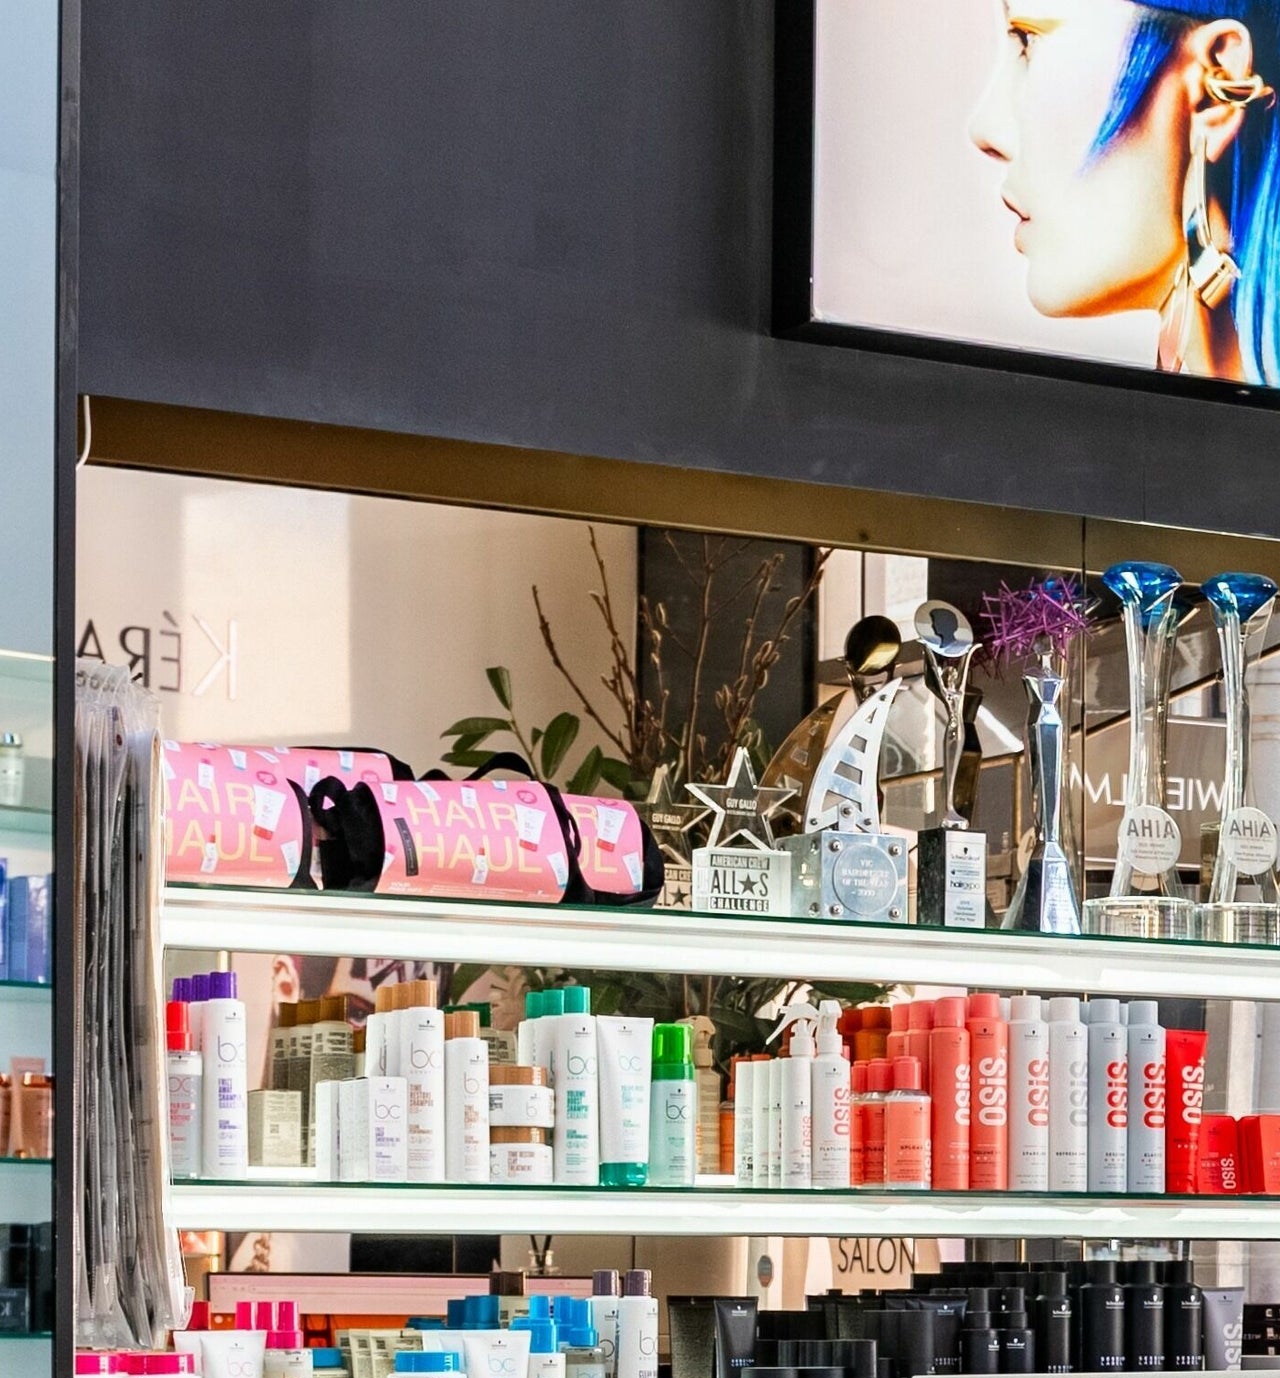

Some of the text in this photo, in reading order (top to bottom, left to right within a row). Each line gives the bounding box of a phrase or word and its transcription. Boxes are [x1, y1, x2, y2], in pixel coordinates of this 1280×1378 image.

[165, 777, 256, 817] AIR
[406, 795, 518, 833] HAIR
[726, 797, 757, 810] GUY GALLO
[165, 820, 274, 863] AUL
[415, 831, 543, 875] HAUL
[711, 855, 770, 870] AMERICAN CREW
[711, 869, 740, 895] ALL
[710, 898, 769, 912] CHALLENGE
[837, 1238, 917, 1275] SALON
